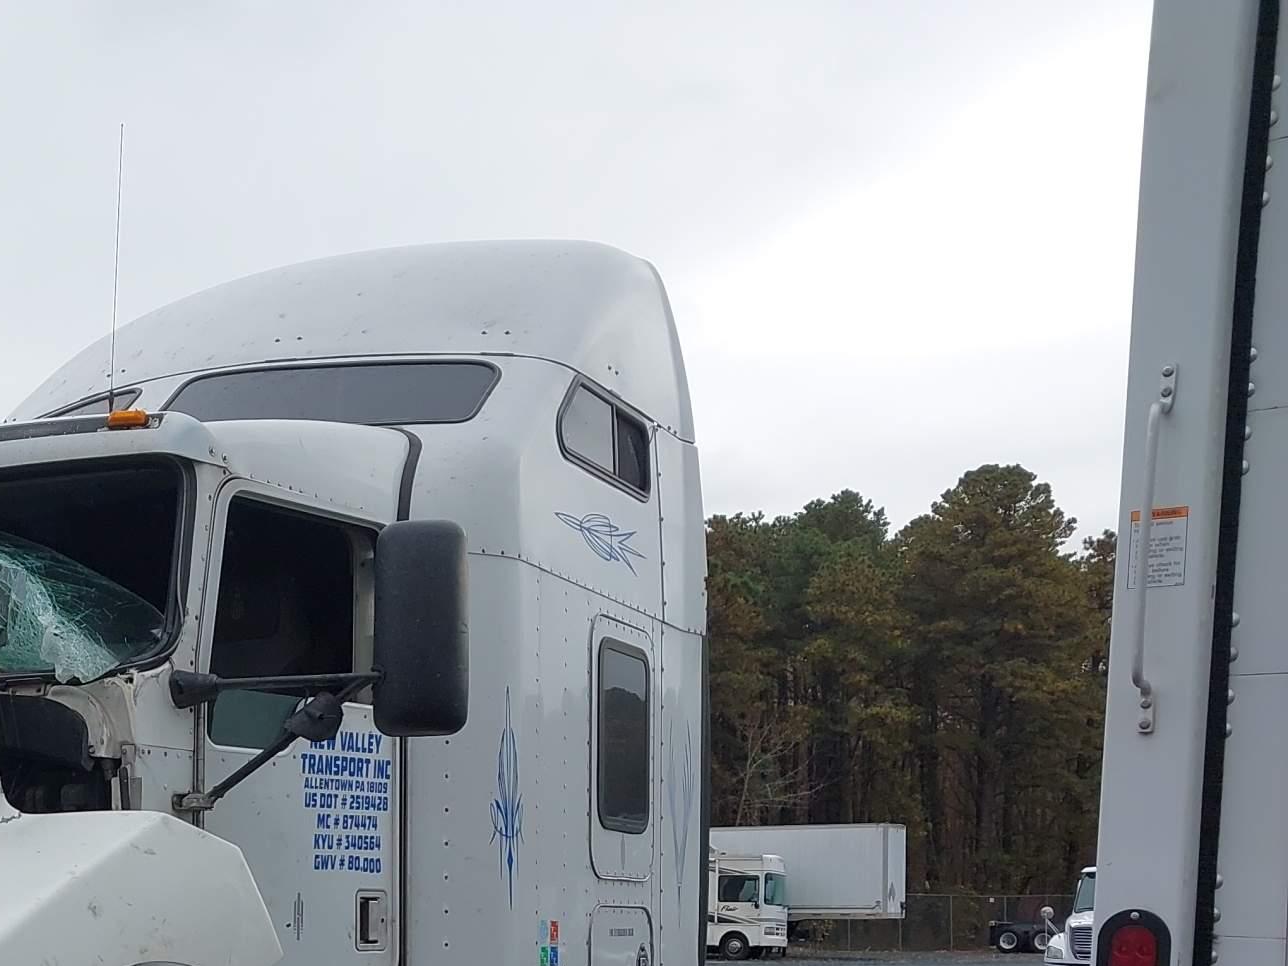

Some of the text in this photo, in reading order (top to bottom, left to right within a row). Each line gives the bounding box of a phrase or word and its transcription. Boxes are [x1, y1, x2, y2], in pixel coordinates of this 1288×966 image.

[340, 731, 382, 754] VALLEY
[301, 753, 391, 780] TRANSPORT INC
[304, 777, 388, 793] ALLENTOWN PA 18109
[304, 792, 388, 811] US DOT # 2519428
[317, 813, 377, 831] MC # 874474
[314, 834, 381, 851] KYU # 340564
[314, 855, 337, 870] GWV
[339, 855, 345, 870] #
